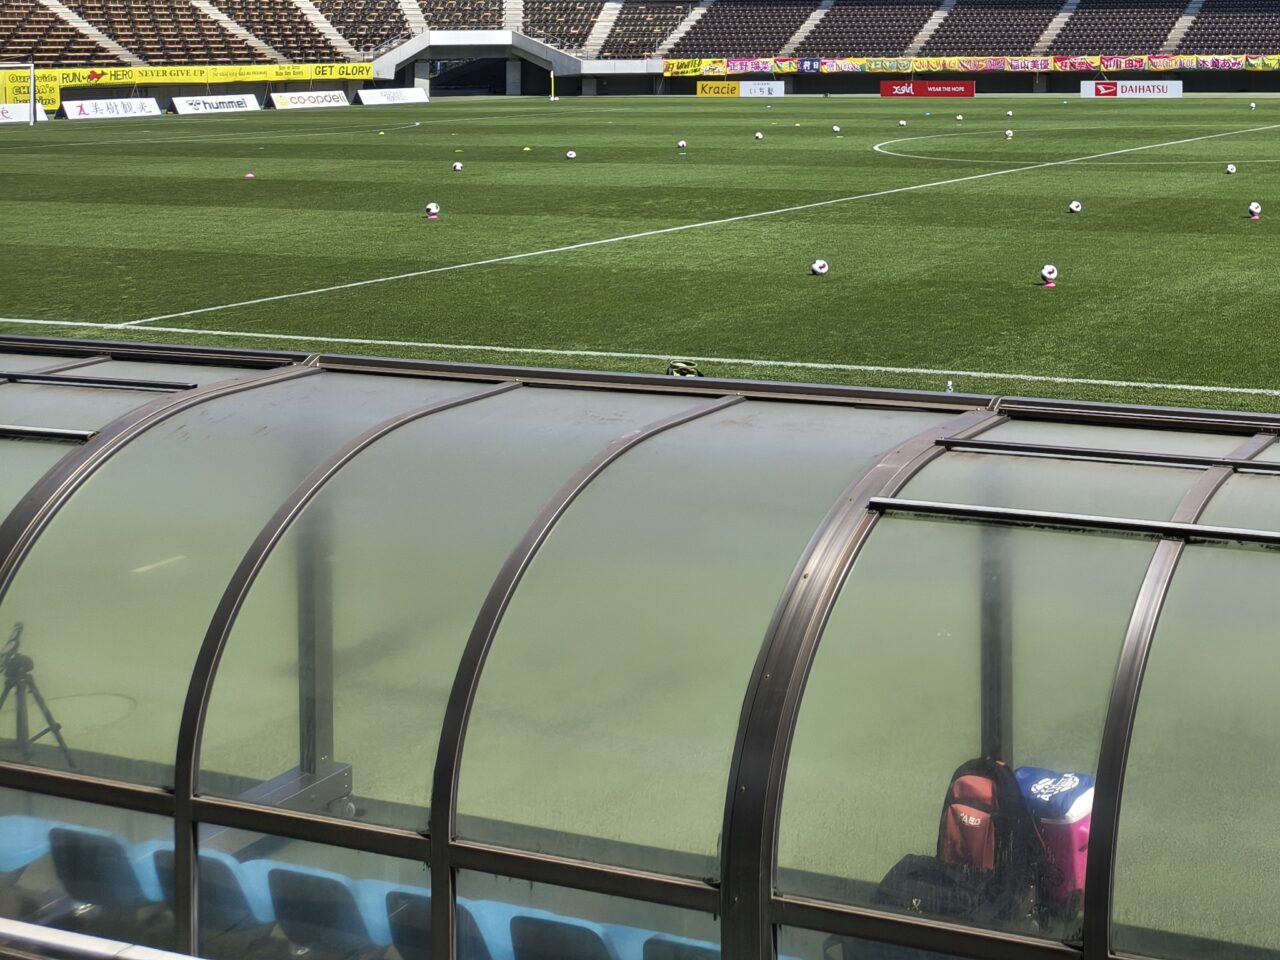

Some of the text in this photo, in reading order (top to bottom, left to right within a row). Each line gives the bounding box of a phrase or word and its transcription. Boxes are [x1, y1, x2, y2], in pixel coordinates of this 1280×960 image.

[109, 70, 133, 81] HERO
[138, 69, 168, 77] NEVER
[169, 69, 192, 77] GIVE
[193, 69, 205, 77] UP
[314, 66, 335, 76] GET
[338, 66, 371, 76] GLORY
[700, 83, 737, 95] Kracie
[1121, 84, 1168, 94] DAIHATSU
[203, 98, 247, 110] hummel
